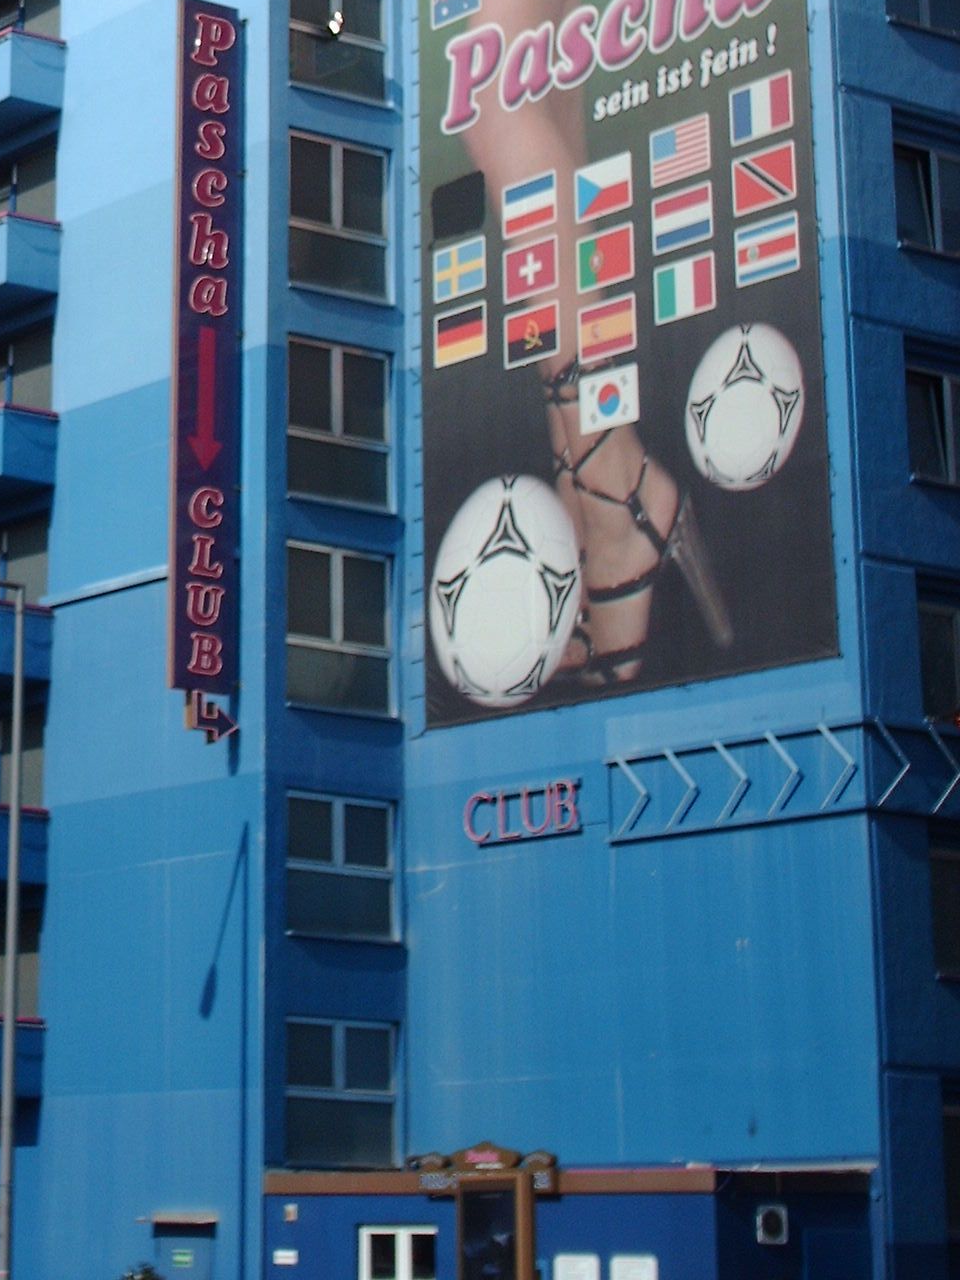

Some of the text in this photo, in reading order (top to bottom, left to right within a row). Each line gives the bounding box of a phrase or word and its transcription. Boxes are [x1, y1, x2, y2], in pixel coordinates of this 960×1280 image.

[593, 22, 778, 122] sein ist fein !
[190, 14, 235, 317] Pascha
[187, 487, 224, 676] CLUB
[464, 780, 578, 842] CLUB
